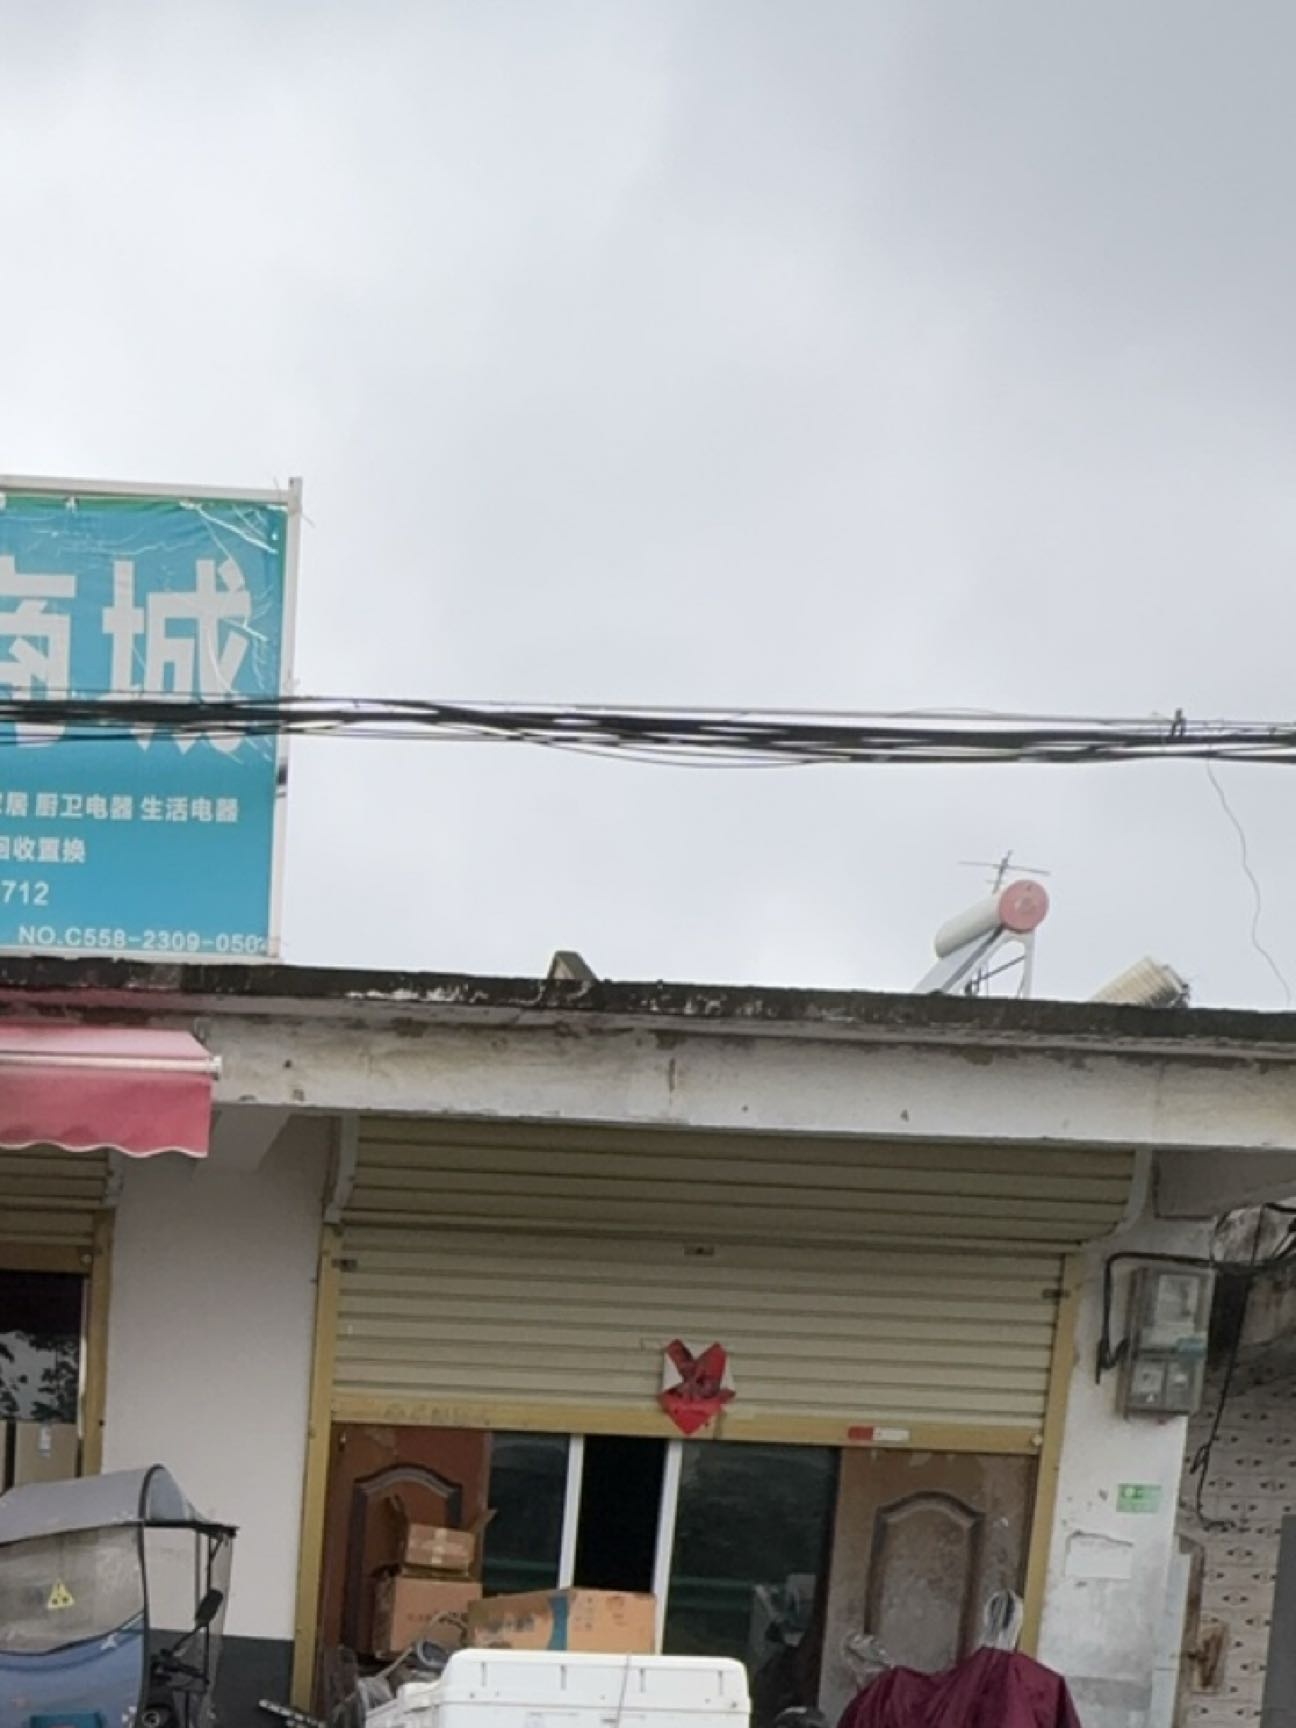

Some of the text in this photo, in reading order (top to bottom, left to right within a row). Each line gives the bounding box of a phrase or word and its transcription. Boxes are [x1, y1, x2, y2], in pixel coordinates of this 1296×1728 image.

[34, 791, 134, 821] 厨卫电器
[140, 795, 240, 823] 生活电器
